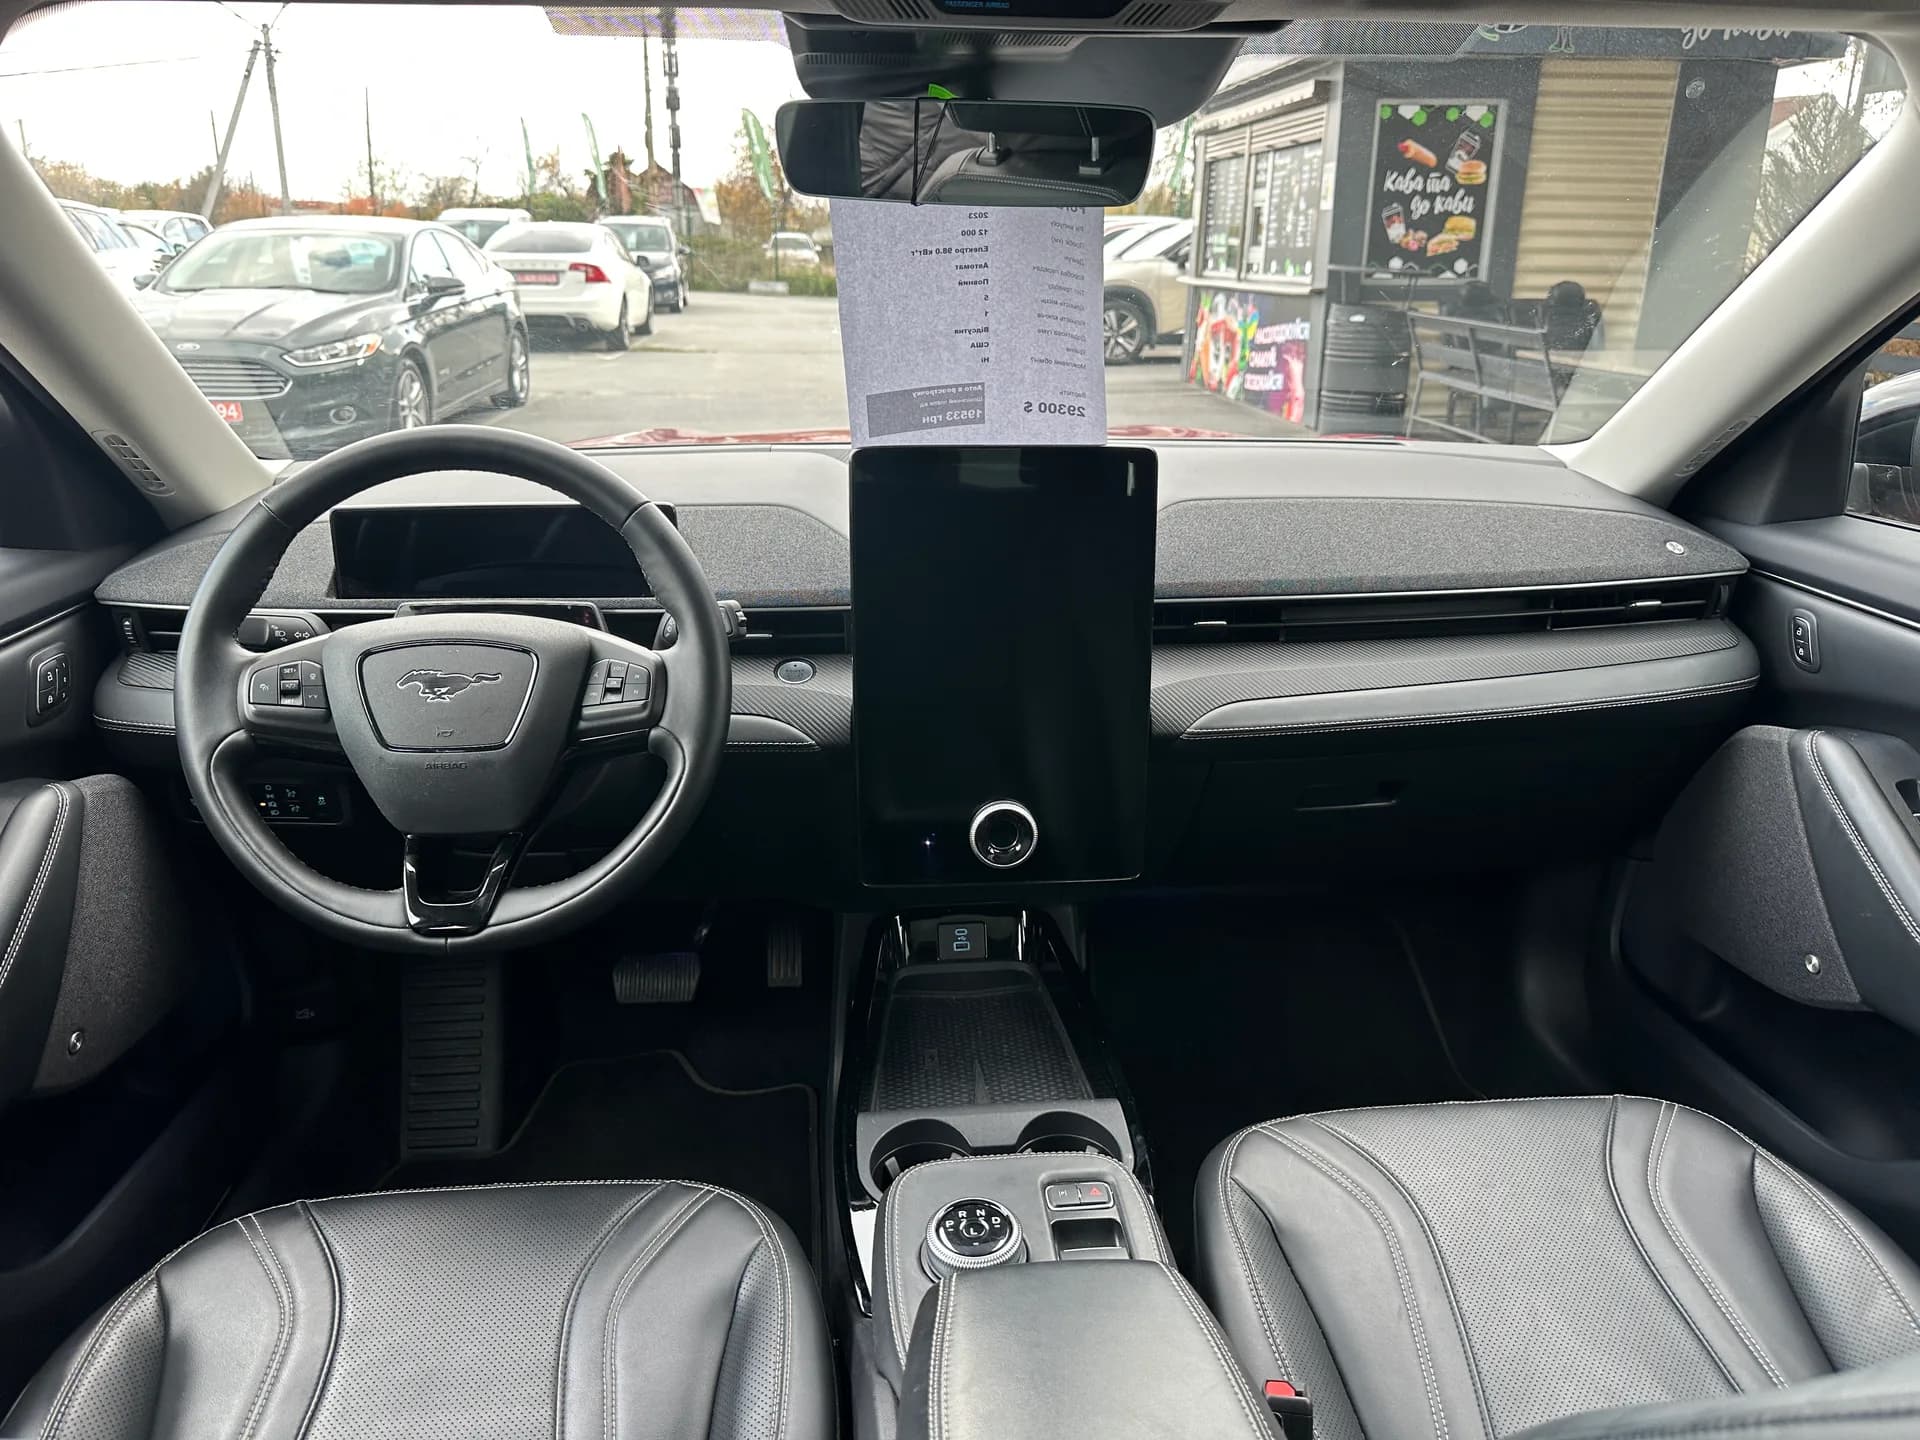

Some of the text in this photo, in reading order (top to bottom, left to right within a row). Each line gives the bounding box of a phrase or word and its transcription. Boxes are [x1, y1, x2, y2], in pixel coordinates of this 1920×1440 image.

[1383, 167, 1425, 194] Кава
[1410, 188, 1475, 220] до кави
[425, 761, 468, 770] AIRBAG
[945, 1209, 1001, 1228] P R N D
